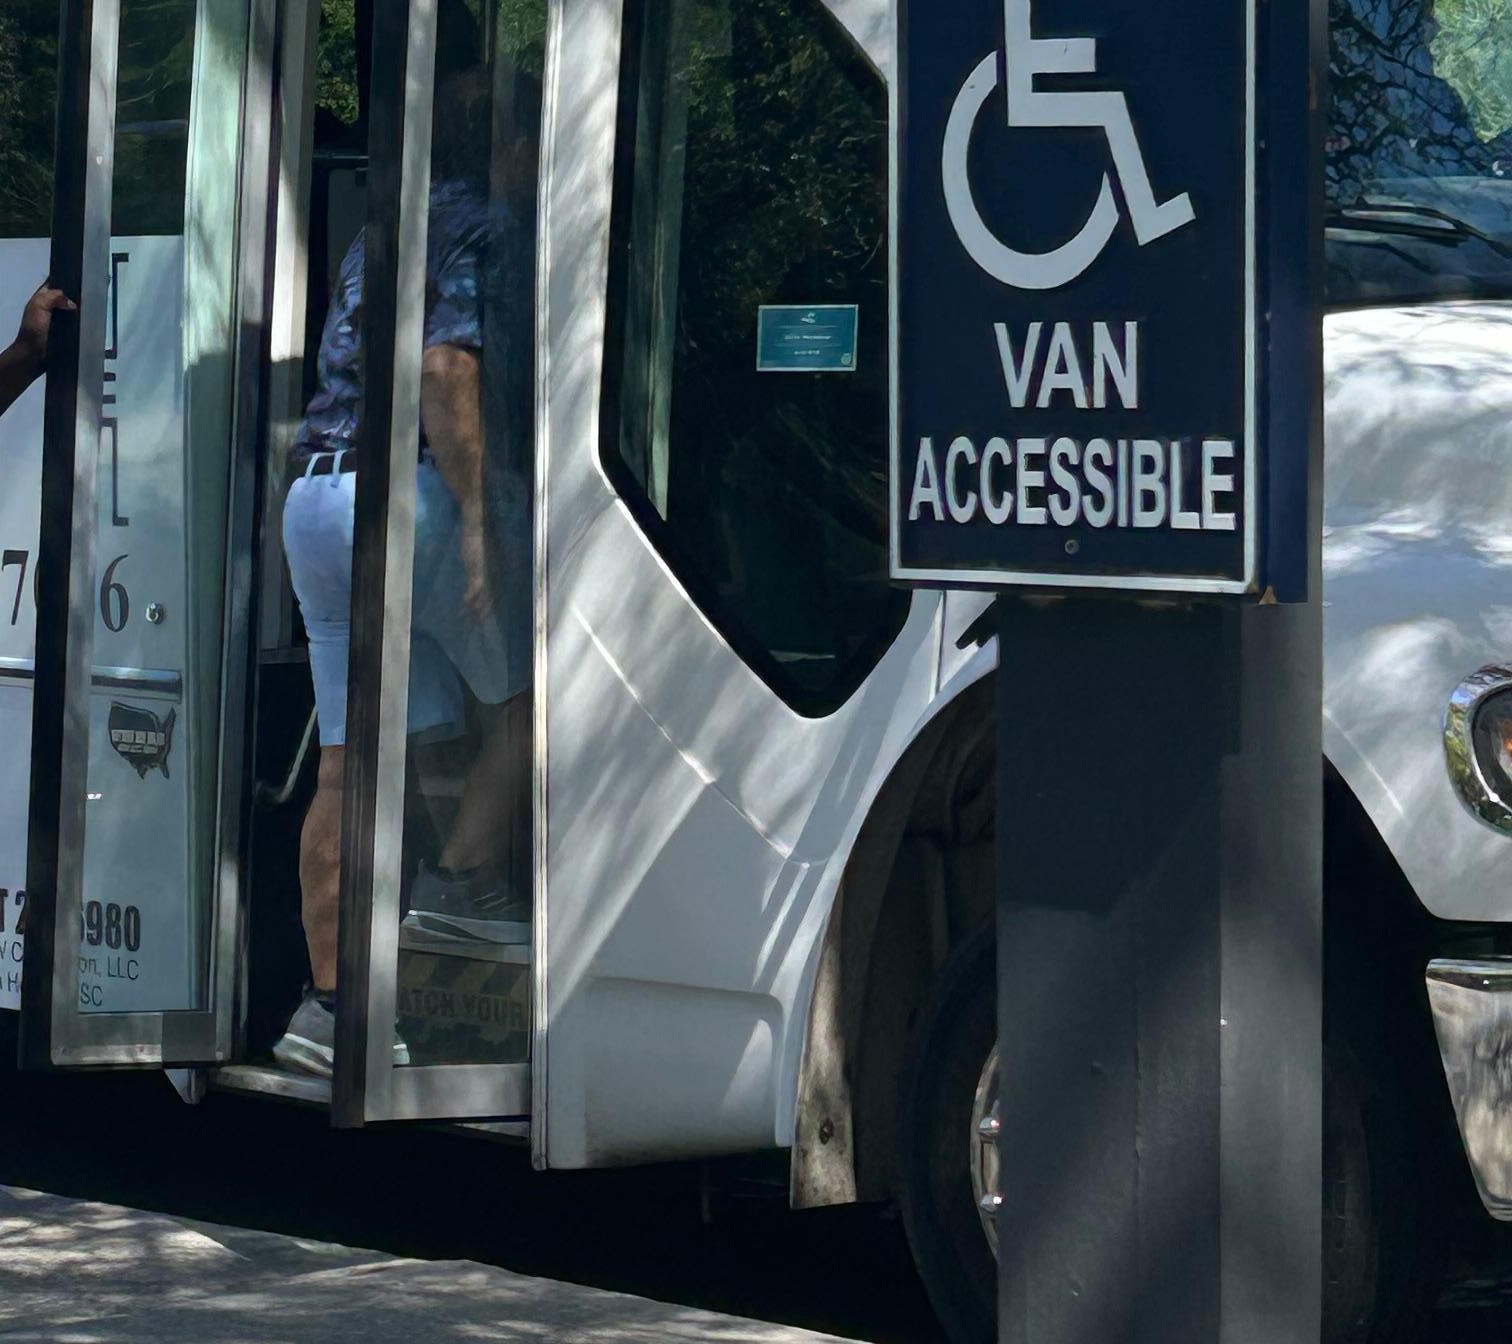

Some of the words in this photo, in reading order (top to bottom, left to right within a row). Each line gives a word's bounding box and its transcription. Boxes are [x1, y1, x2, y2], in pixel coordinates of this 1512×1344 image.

[994, 321, 1138, 409] VAN
[908, 436, 1236, 531] ACCESSIBLE
[80, 985, 103, 1007] SC
[107, 956, 139, 981] LLC
